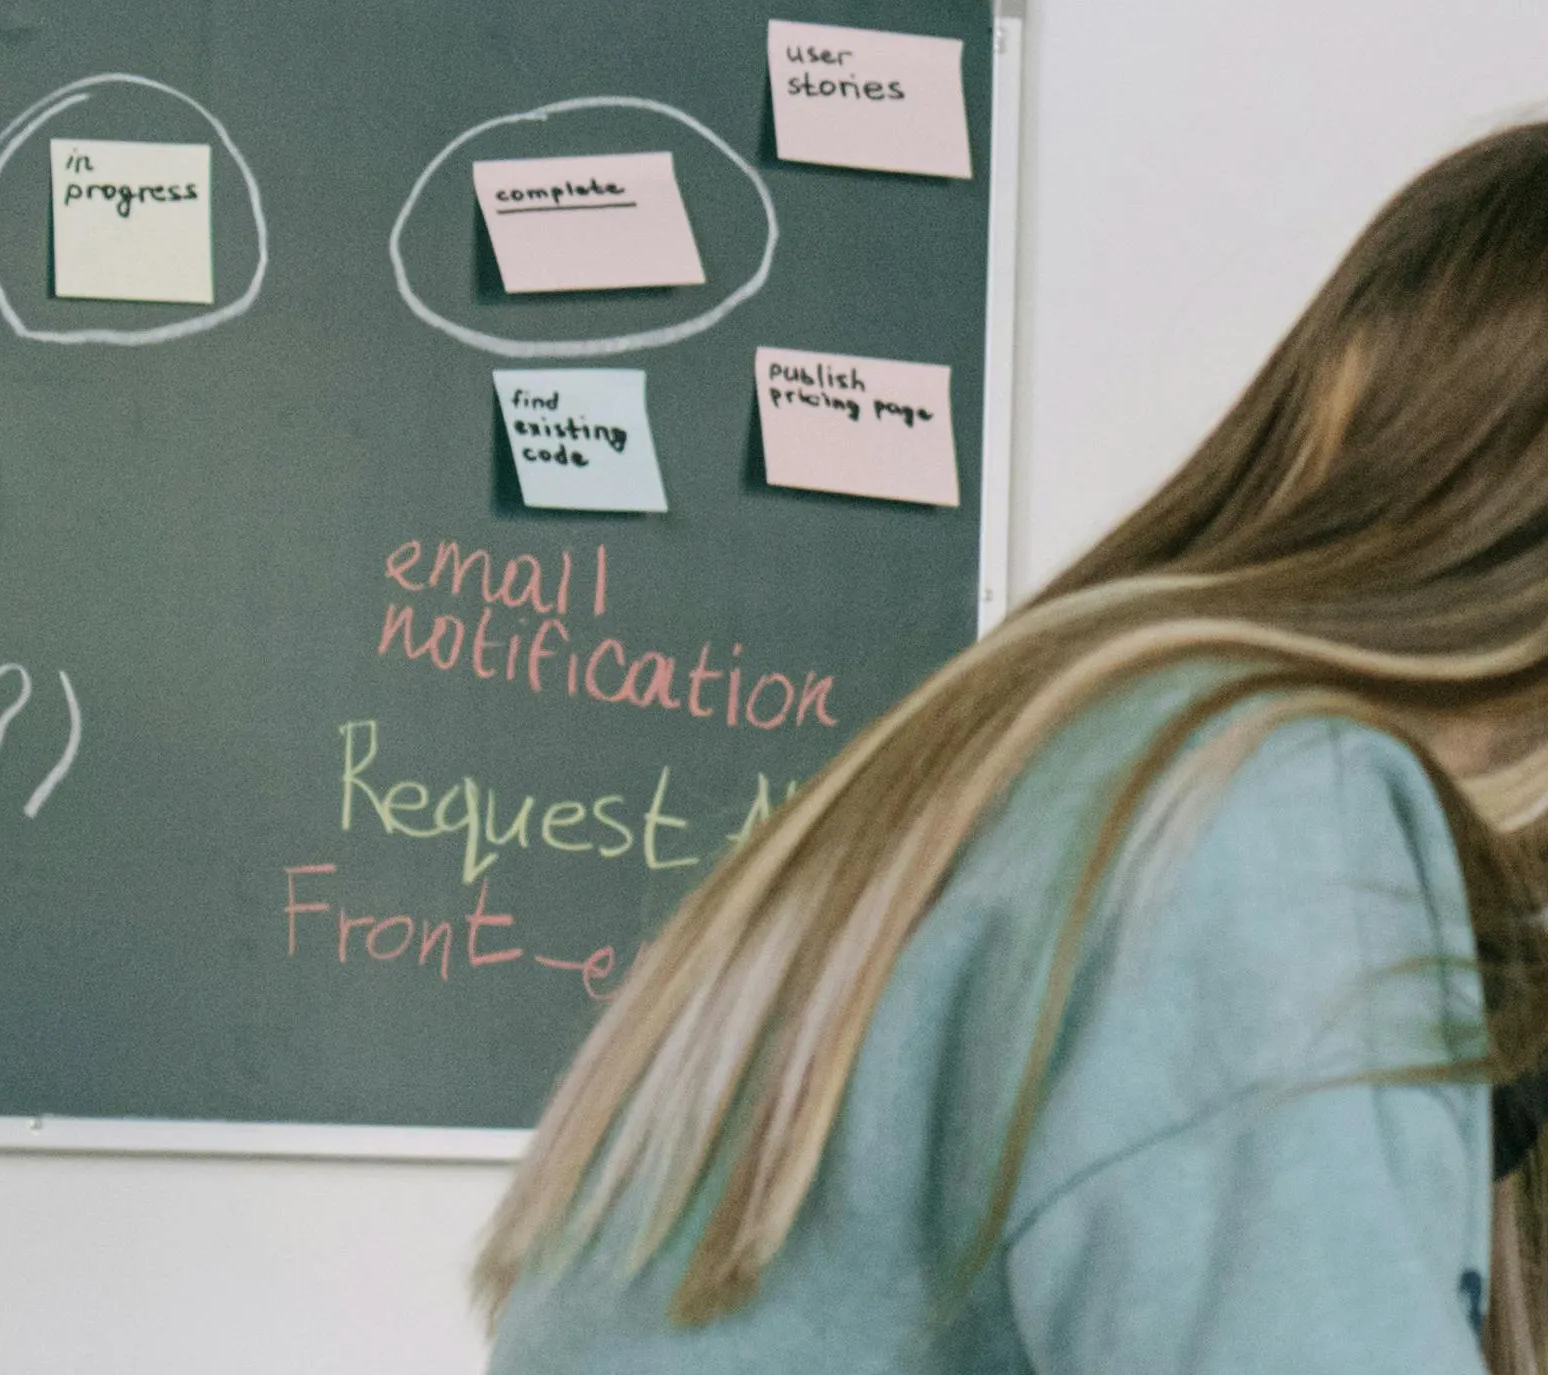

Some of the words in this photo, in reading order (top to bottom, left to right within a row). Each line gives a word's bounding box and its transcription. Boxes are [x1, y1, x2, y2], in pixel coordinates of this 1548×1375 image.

[786, 45, 854, 66] user
[787, 72, 905, 100] stories
[65, 147, 94, 173] in
[64, 183, 198, 218] progress
[496, 177, 625, 204] complete
[768, 362, 866, 393] publish
[512, 388, 560, 411] find
[768, 387, 860, 422] pricing
[873, 399, 934, 429] page
[514, 415, 628, 454] existing
[522, 444, 590, 468] code
[385, 538, 609, 616] email
[377, 601, 838, 730] notification
[339, 719, 701, 884] Request
[283, 862, 624, 1002] Front-e
